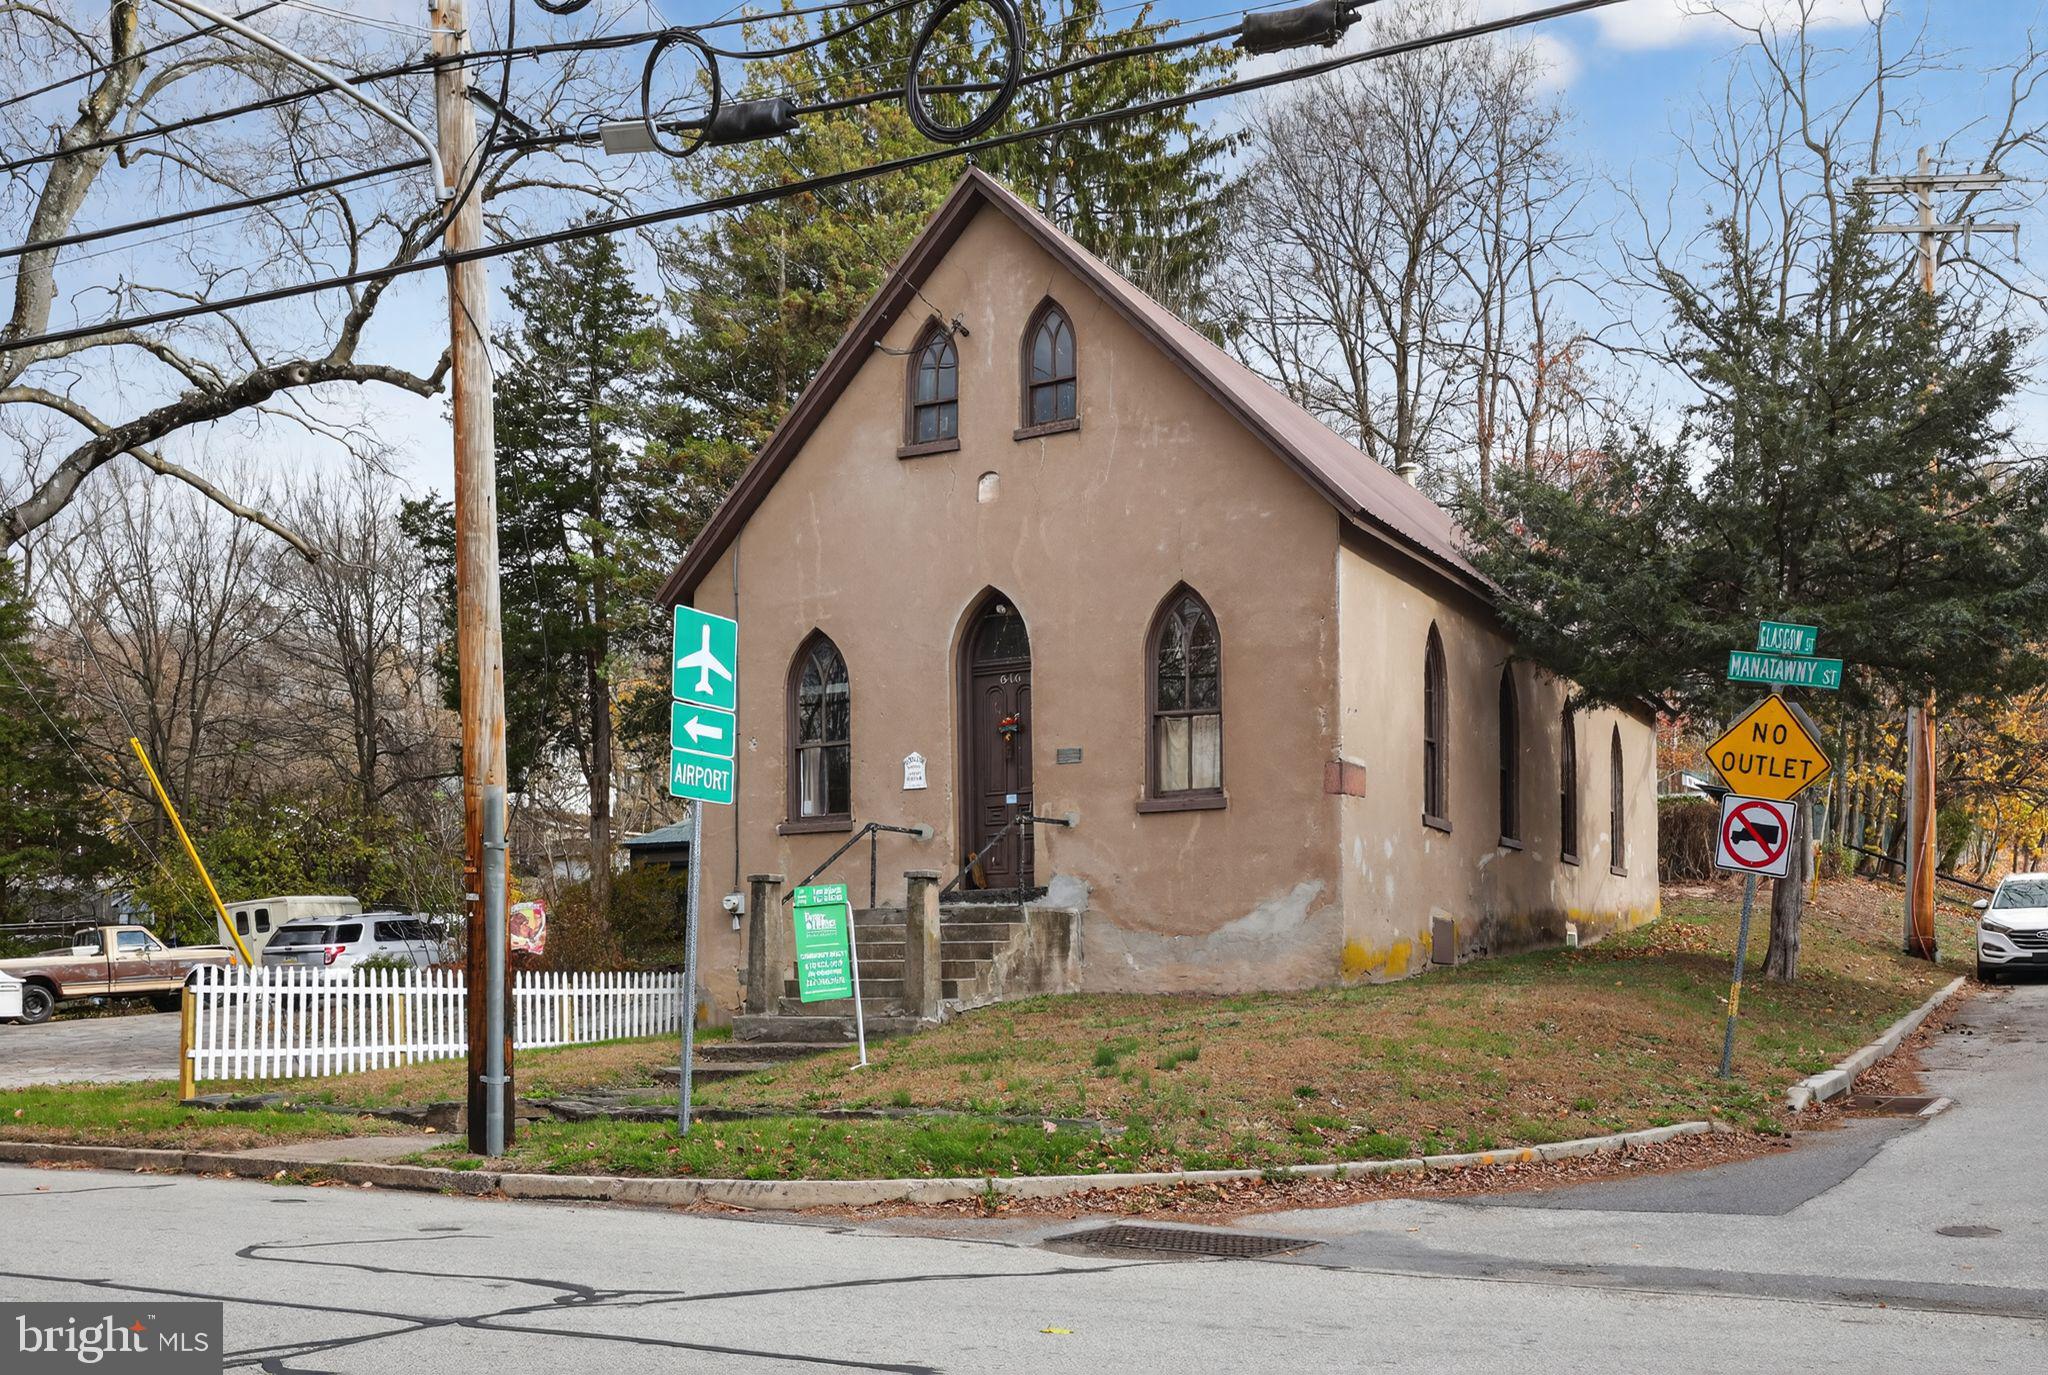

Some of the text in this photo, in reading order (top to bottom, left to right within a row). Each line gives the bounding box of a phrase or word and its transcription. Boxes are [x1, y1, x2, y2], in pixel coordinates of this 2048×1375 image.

[1760, 626, 1816, 652] GLASGOW ST
[1730, 655, 1837, 687] MANATAWNY ST
[1752, 722, 1787, 745] NO
[674, 762, 730, 792] AIRPORT
[1721, 751, 1813, 780] OUTLET
